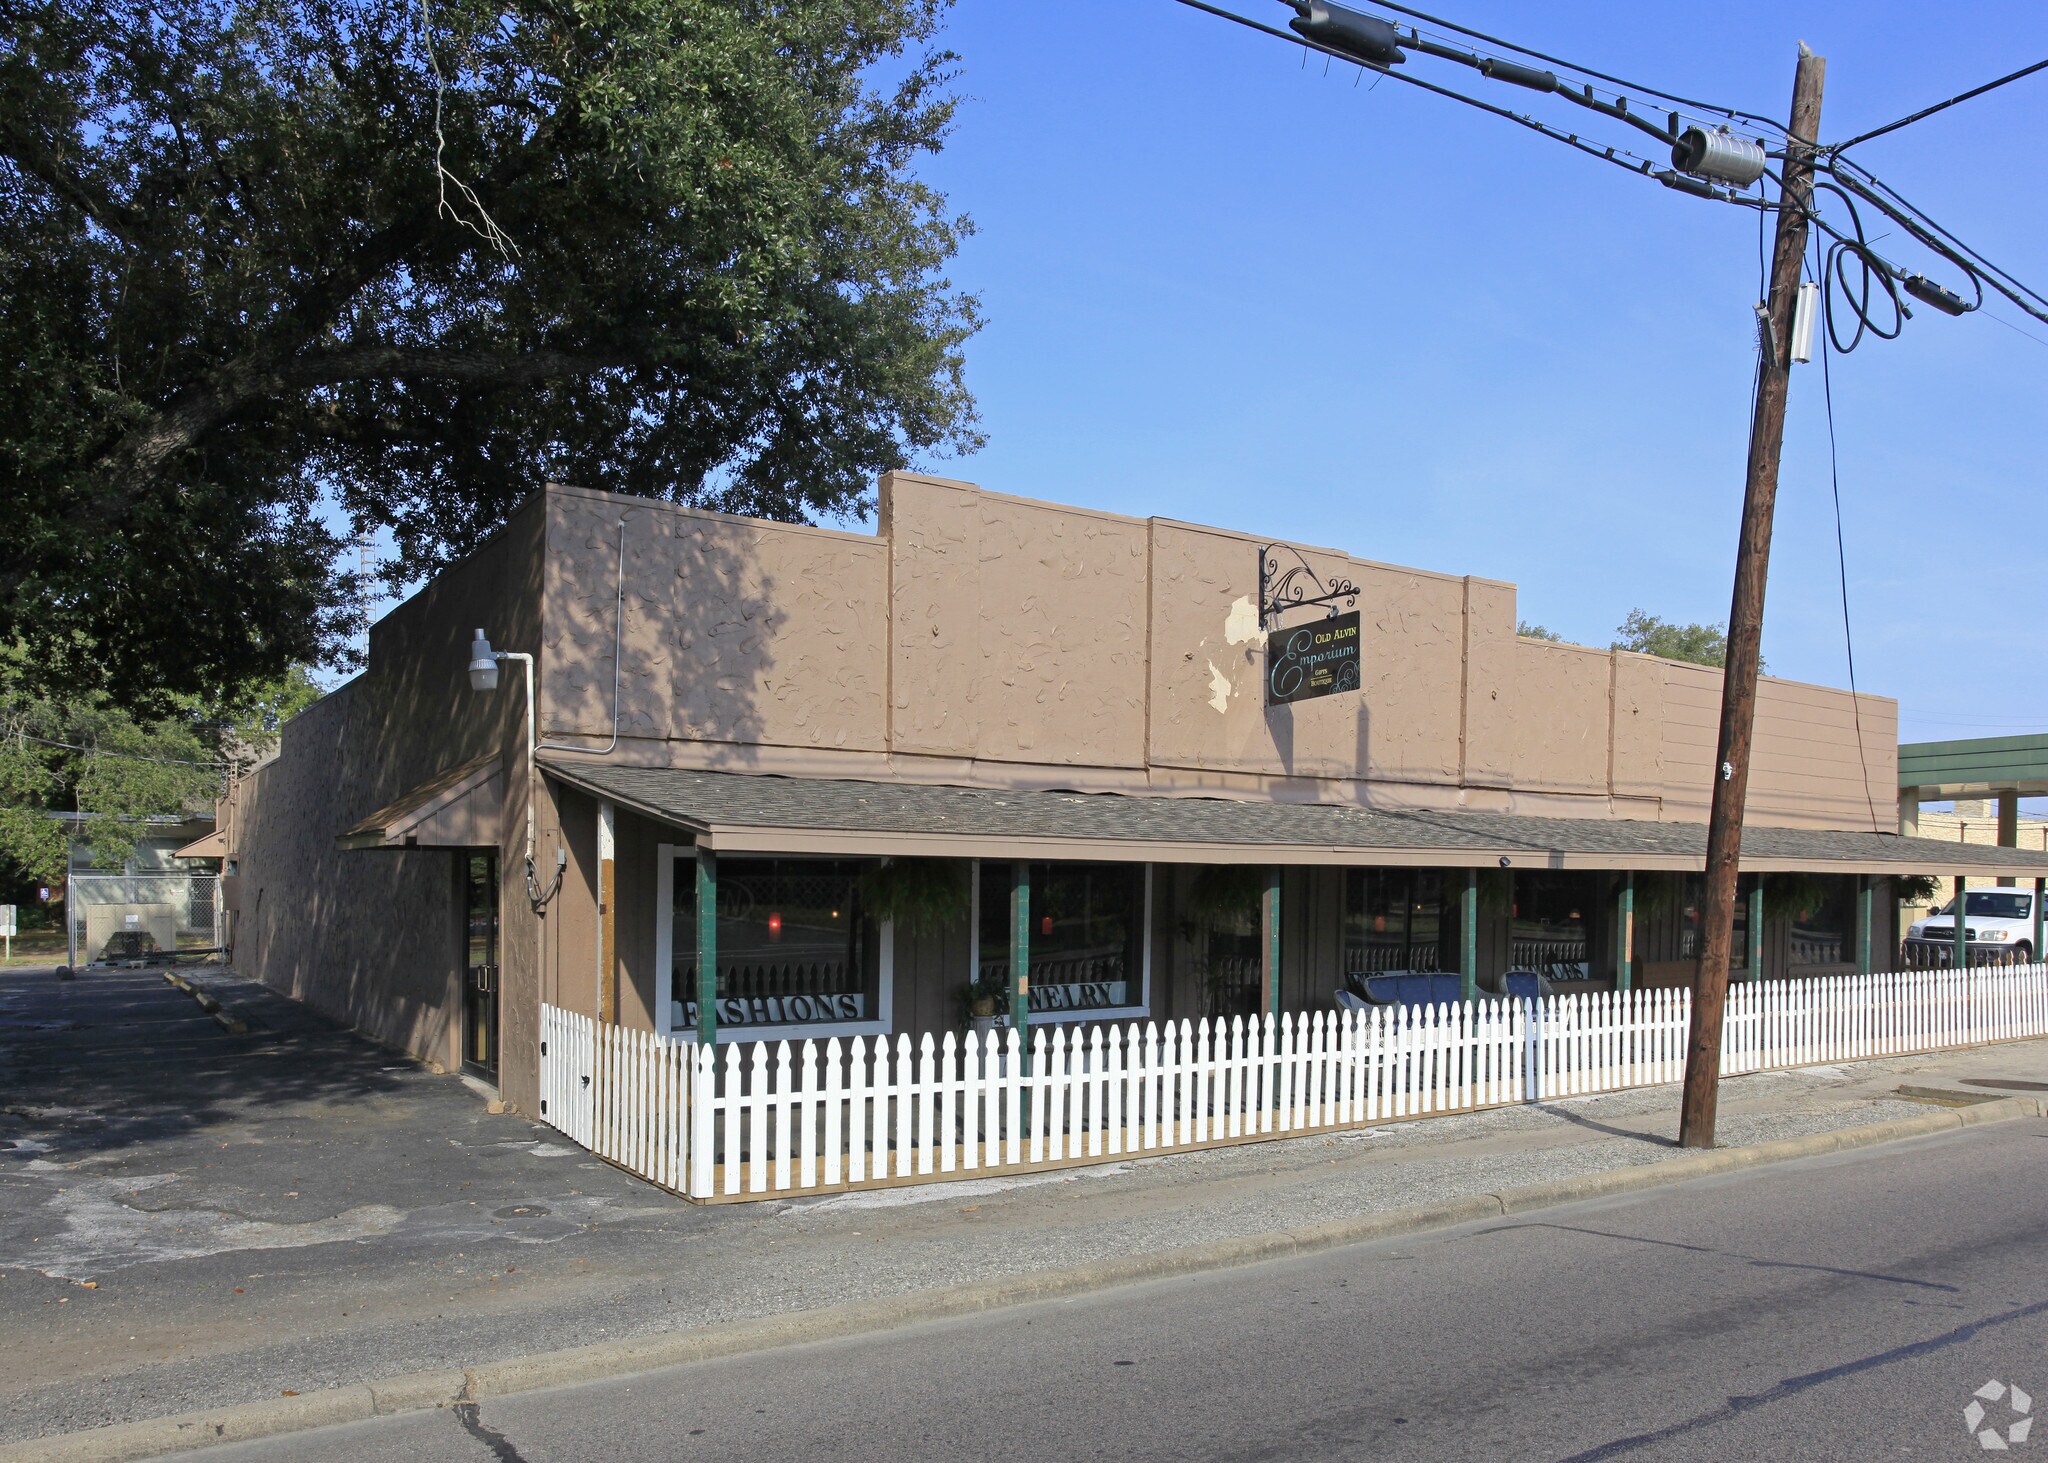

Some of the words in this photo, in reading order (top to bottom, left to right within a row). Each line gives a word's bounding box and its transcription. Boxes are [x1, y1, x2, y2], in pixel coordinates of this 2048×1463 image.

[1315, 633, 1332, 644] OLD
[1333, 627, 1357, 640] ALVIN
[1271, 629, 1357, 697] Emporium
[1006, 982, 1113, 1011] WELRY
